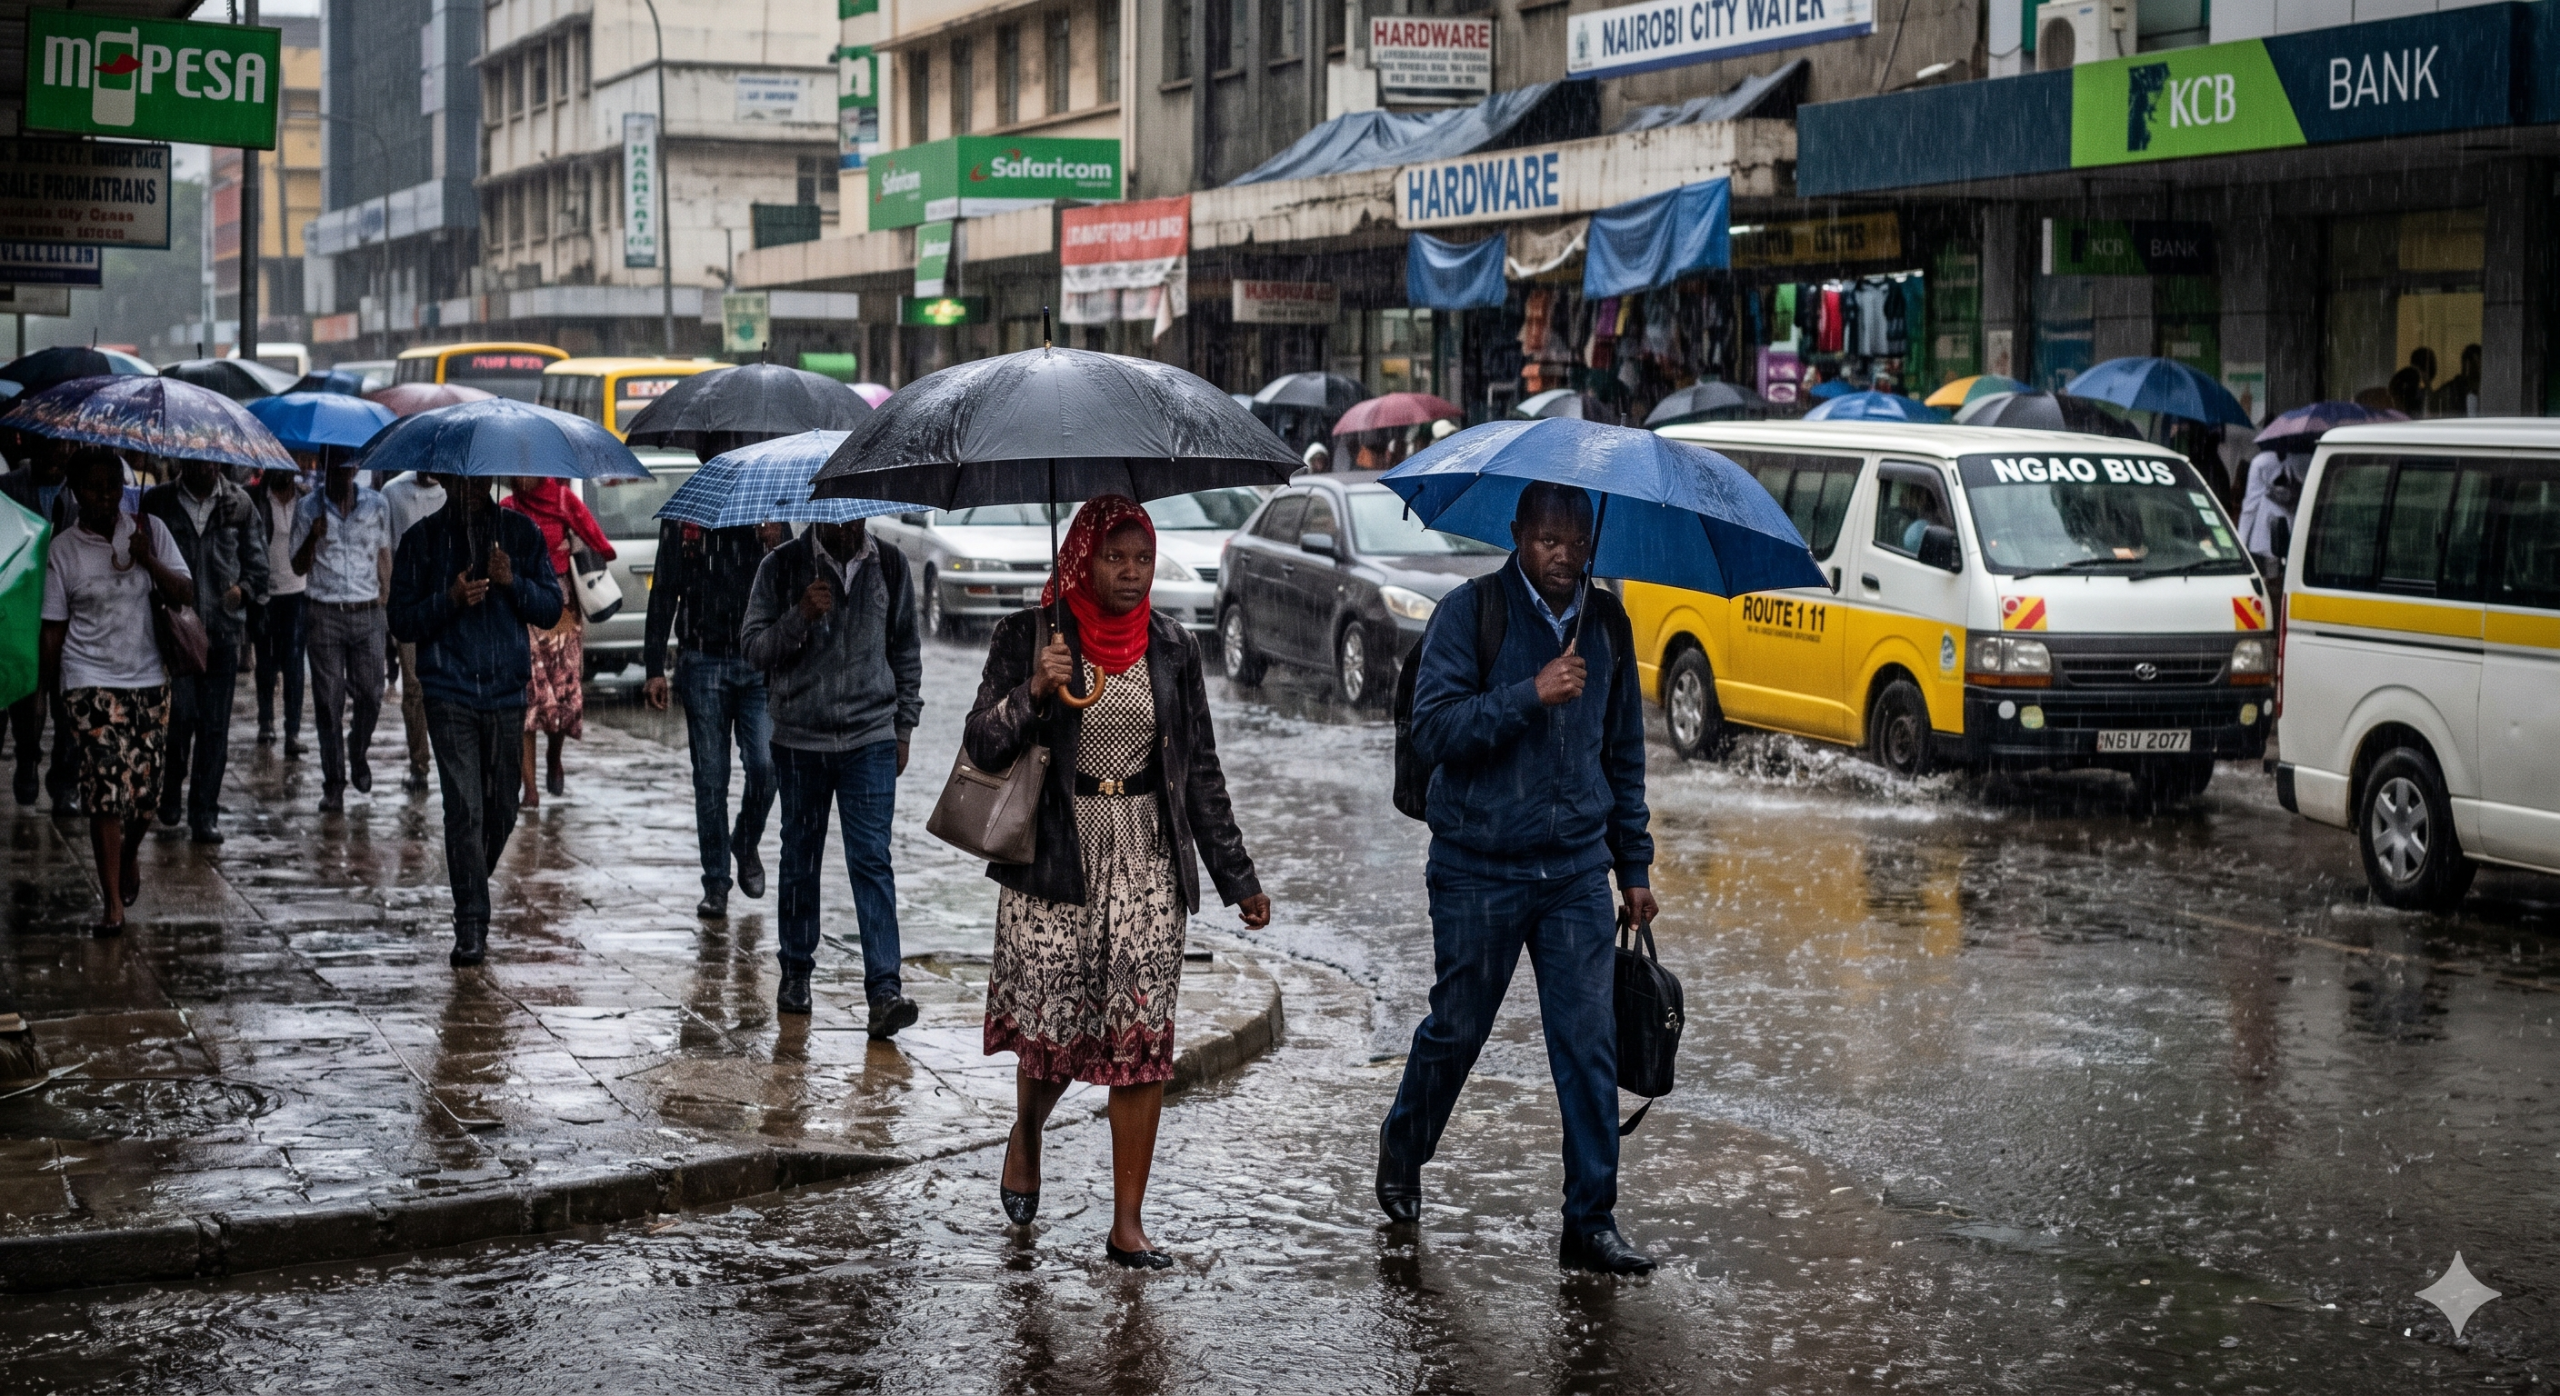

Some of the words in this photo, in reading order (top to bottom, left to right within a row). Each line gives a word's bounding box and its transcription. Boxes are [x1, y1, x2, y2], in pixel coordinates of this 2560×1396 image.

[1374, 20, 1490, 49] HARDWARE
[1602, 5, 1683, 58] NAIROBI
[1690, 0, 1738, 41] CITY
[2169, 73, 2237, 128] KCB
[2328, 45, 2440, 111] BANK
[991, 156, 1113, 181] Safaricom
[1407, 151, 1559, 221] HARDWARE
[2091, 238, 2125, 257] KCB
[2150, 238, 2200, 258] BANK
[1990, 457, 2098, 484] NGAO
[2101, 458, 2177, 486] BUS
[1742, 595, 1794, 628] ROUTE
[2146, 731, 2189, 750] 2077
